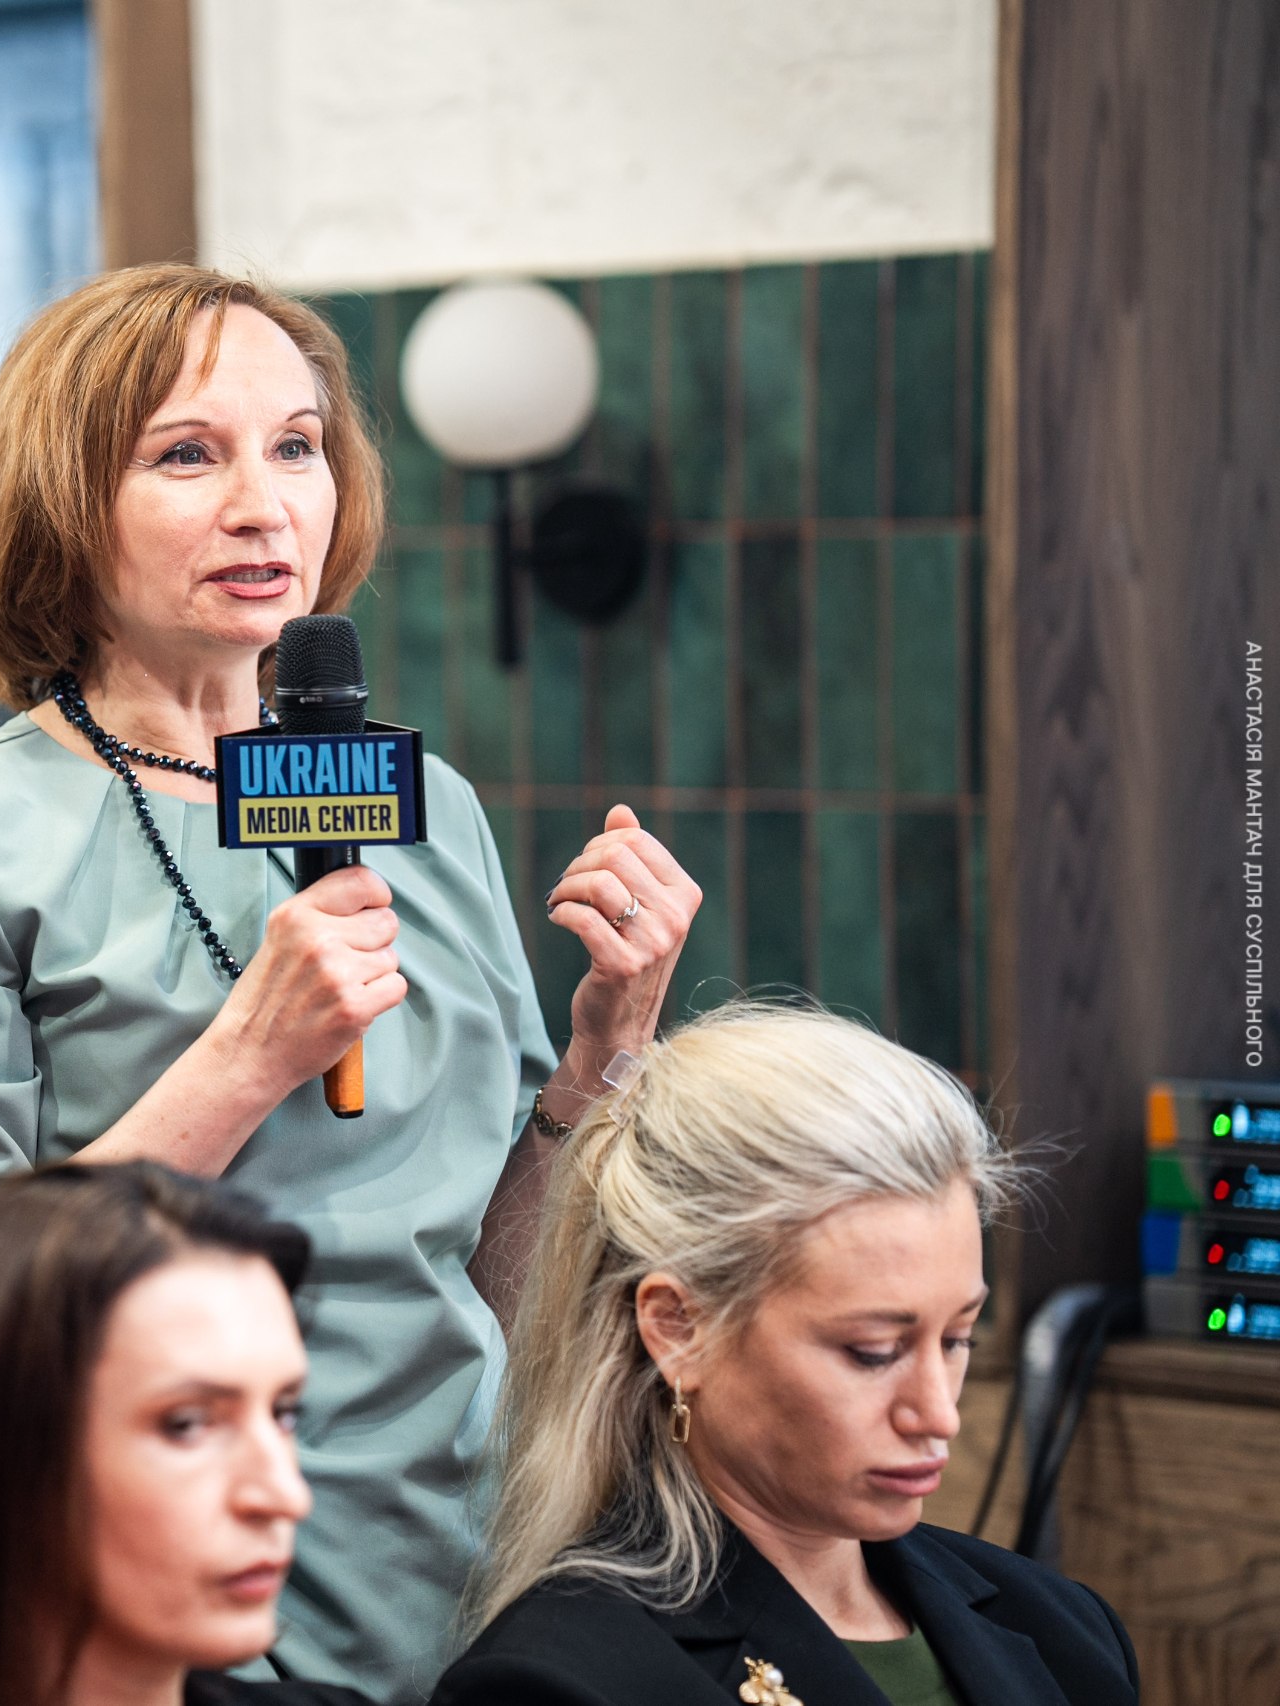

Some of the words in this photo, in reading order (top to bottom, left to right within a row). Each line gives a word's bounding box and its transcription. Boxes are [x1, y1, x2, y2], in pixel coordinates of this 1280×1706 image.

[239, 741, 397, 796] UKRAINE
[246, 806, 311, 835] MEDIA
[318, 804, 392, 832] CENTER
